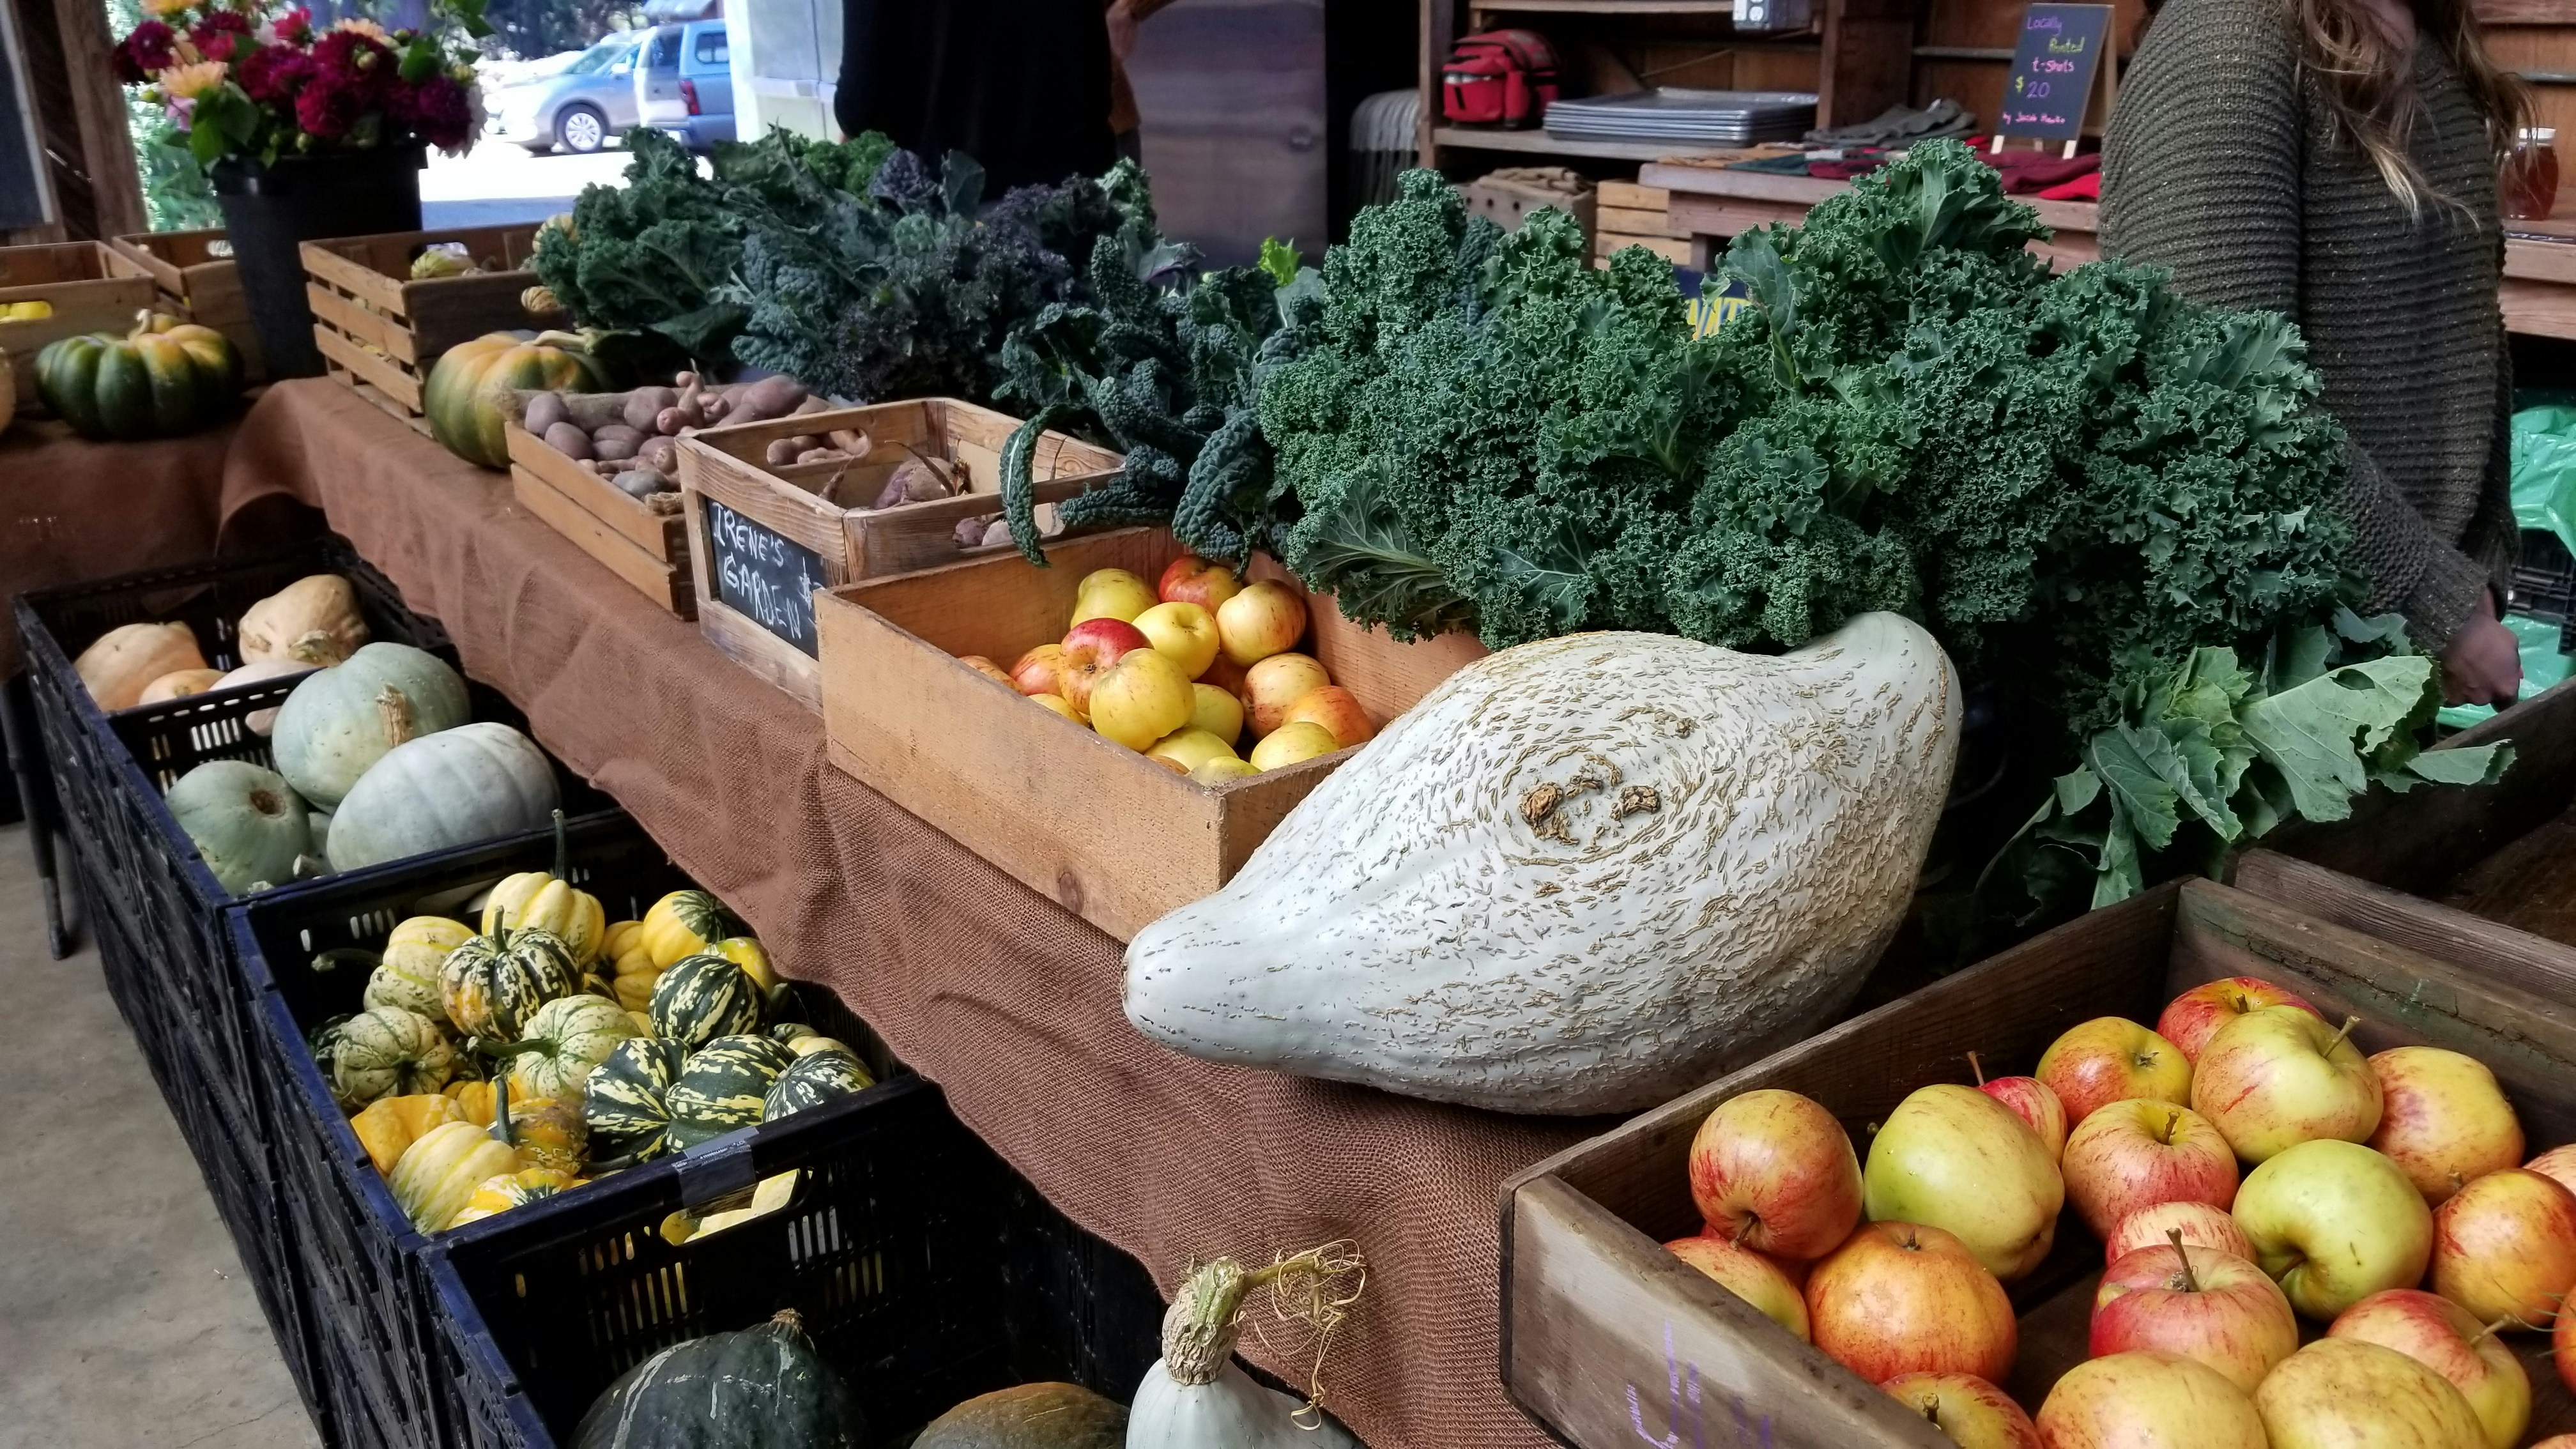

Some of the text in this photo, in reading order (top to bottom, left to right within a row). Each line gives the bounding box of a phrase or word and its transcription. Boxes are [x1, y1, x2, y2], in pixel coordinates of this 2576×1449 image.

[2027, 17, 2062, 36] Locally
[712, 503, 785, 567] IRENE'S
[723, 551, 802, 639] GARDEN
